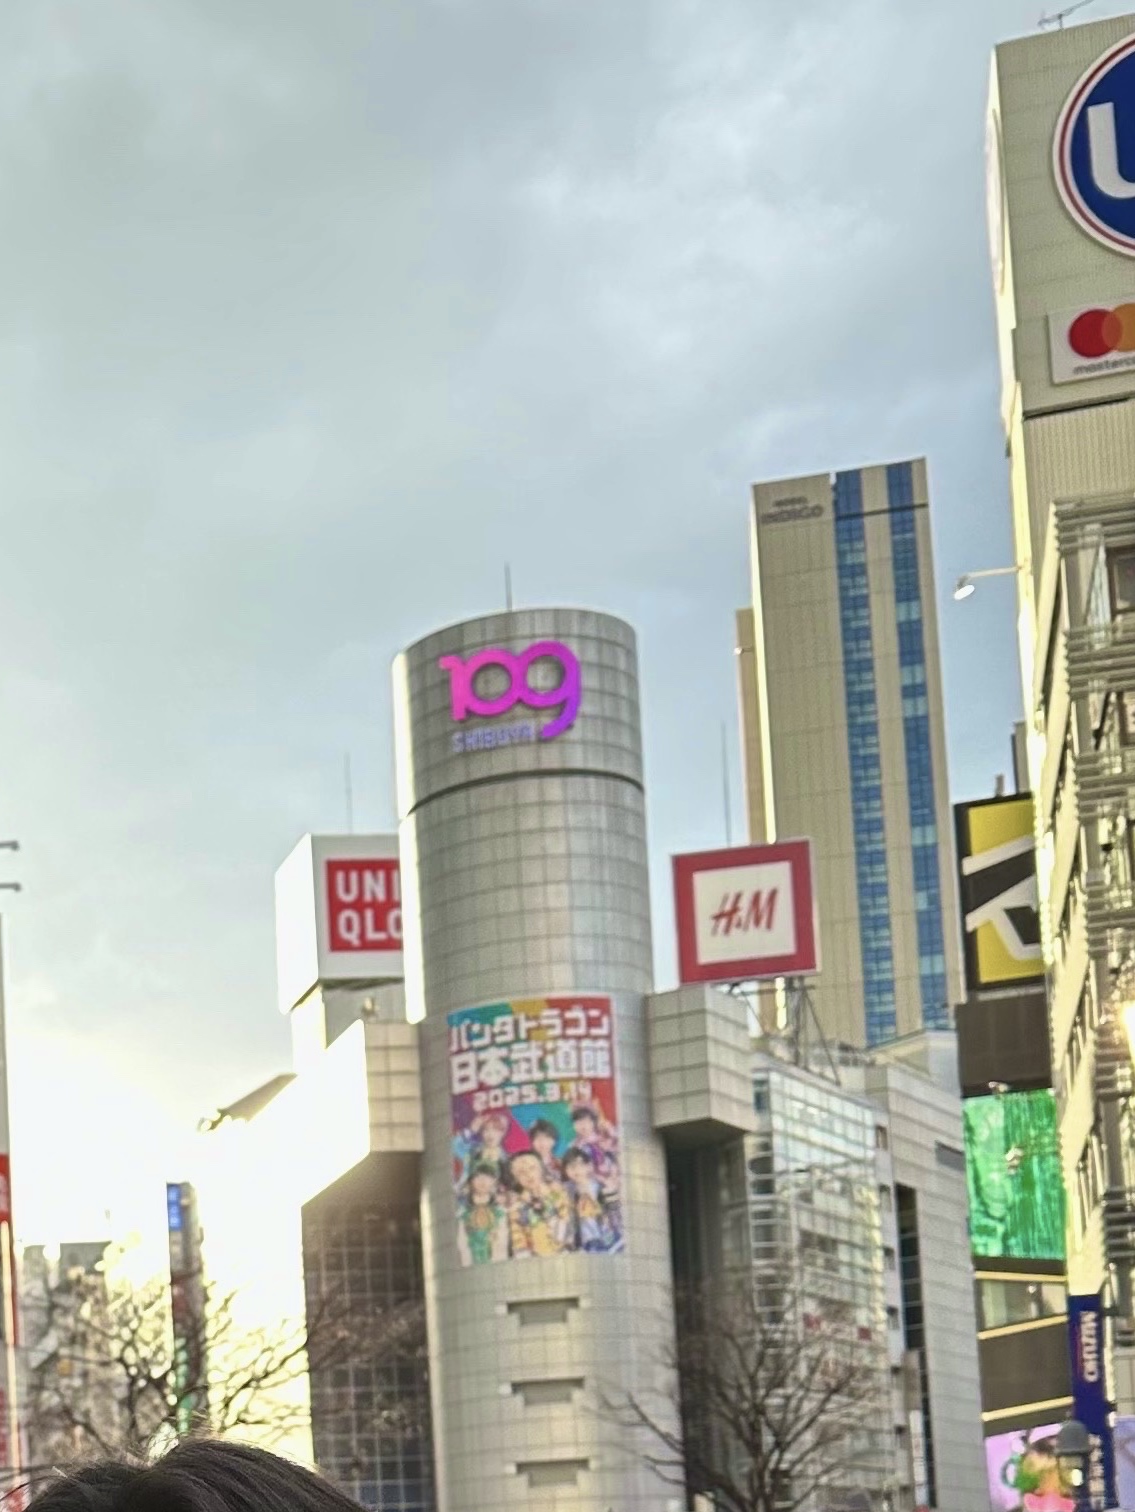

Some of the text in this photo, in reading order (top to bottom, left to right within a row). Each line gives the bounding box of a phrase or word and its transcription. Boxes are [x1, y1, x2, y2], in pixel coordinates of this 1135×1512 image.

[438, 640, 582, 738] 109
[335, 869, 400, 902] UNI
[709, 888, 777, 937] H&M
[450, 1037, 611, 1096] 日本武道館
